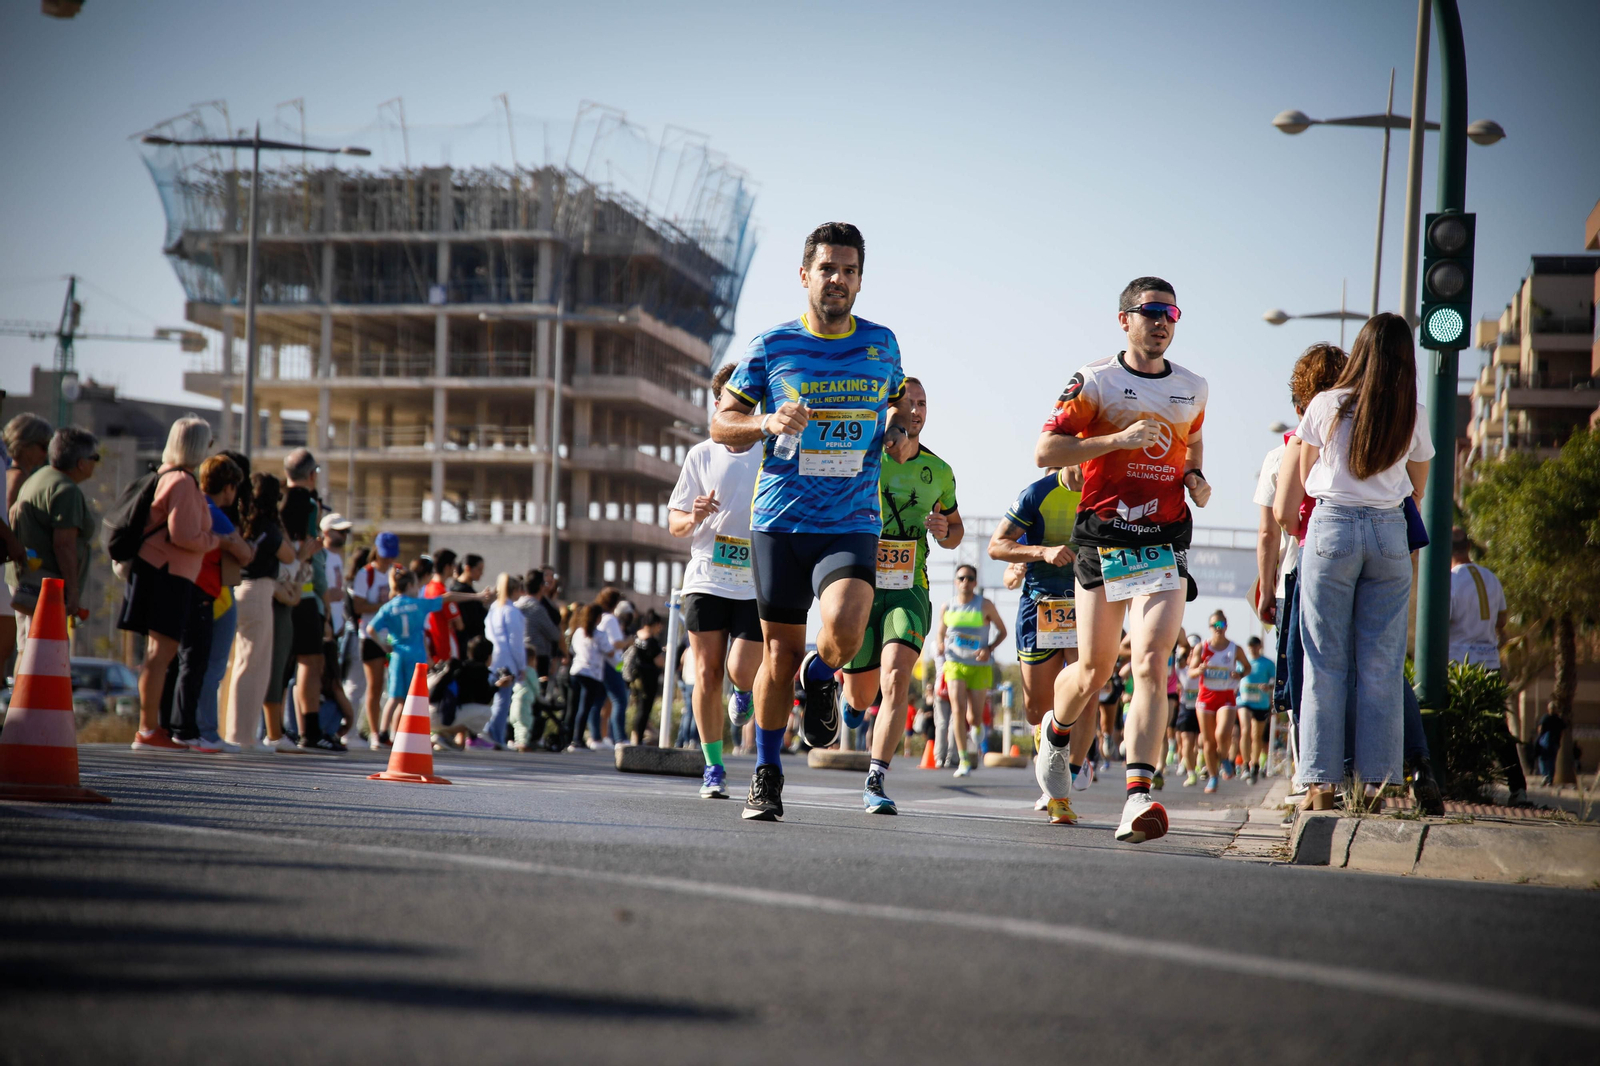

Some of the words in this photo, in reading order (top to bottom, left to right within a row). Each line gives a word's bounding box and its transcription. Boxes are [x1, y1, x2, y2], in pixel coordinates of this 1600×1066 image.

[801, 379, 868, 395] BREAKING
[871, 379, 878, 393] 3
[861, 395, 879, 403] ALONE
[817, 421, 863, 441] 749
[1126, 470, 1159, 480] SALINAS
[1160, 474, 1175, 482] CAR
[877, 548, 910, 563] 536
[1128, 562, 1149, 571] PABLO
